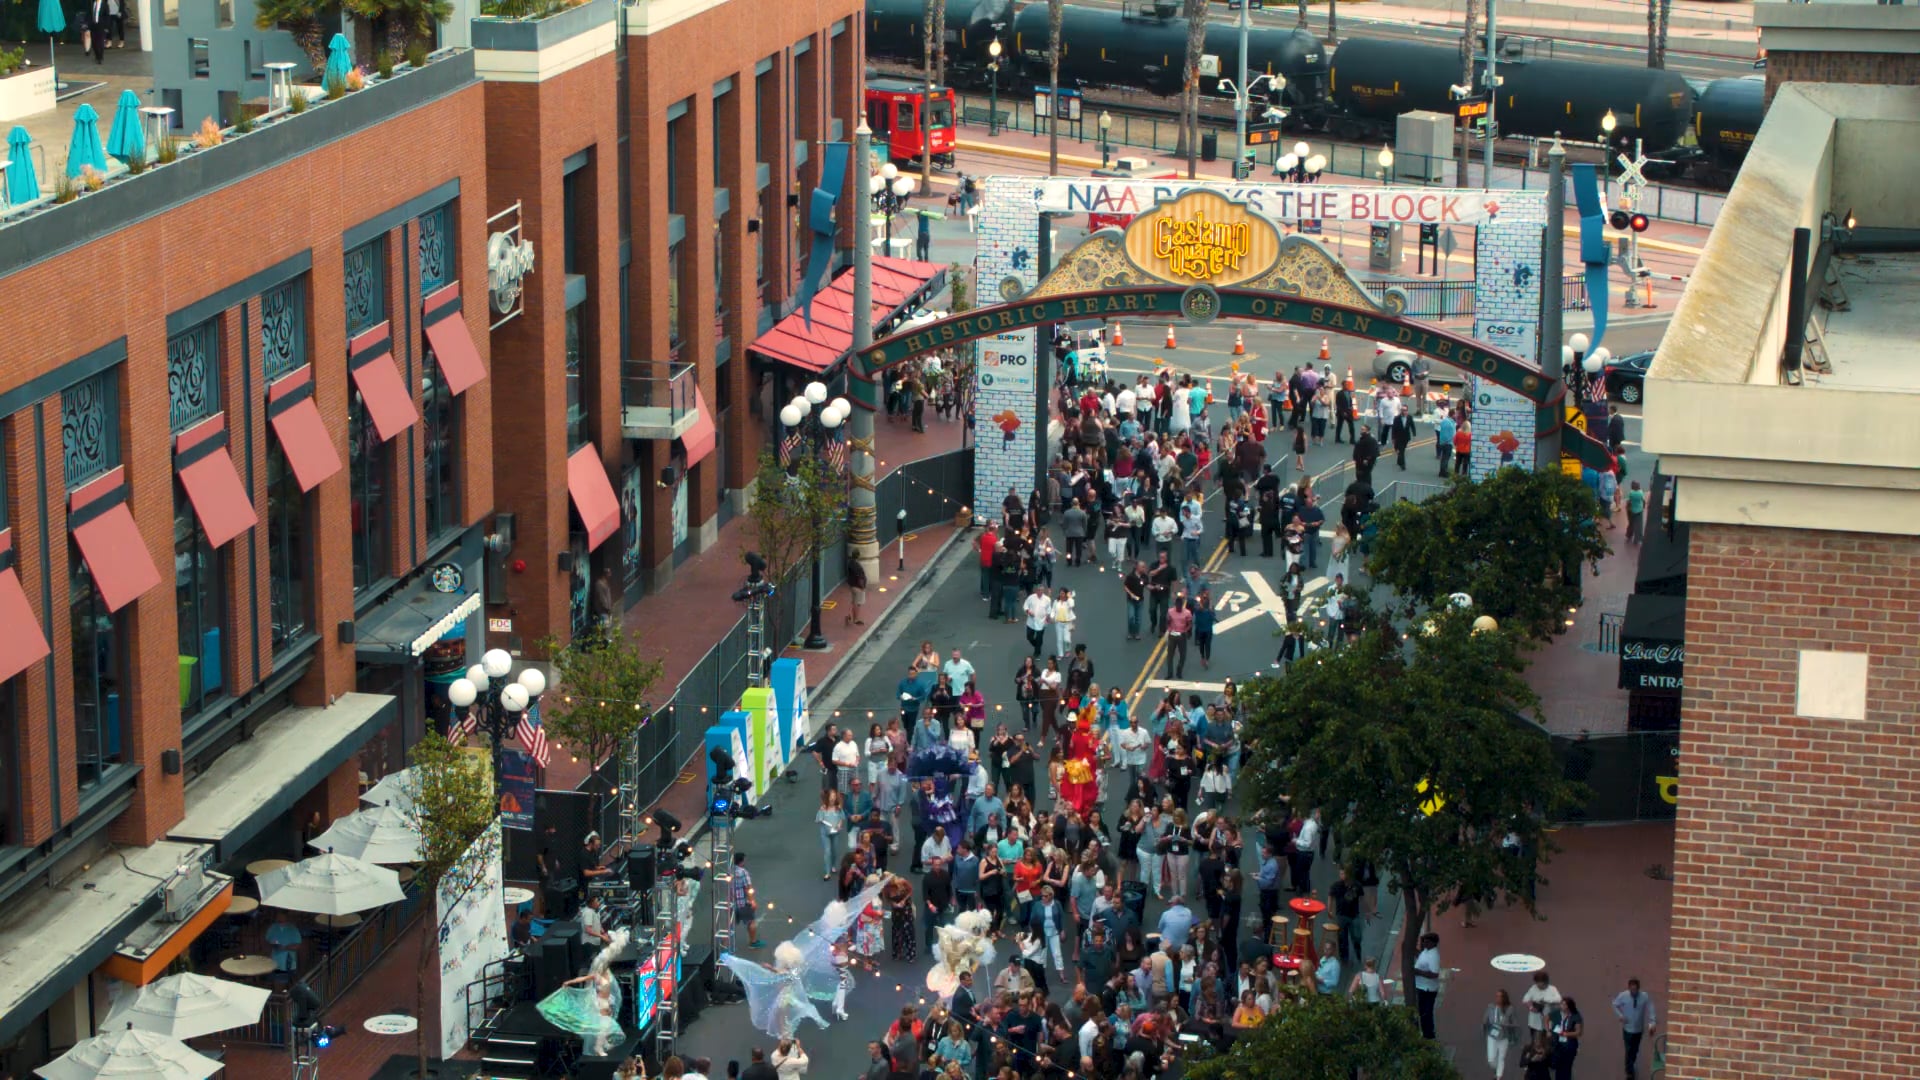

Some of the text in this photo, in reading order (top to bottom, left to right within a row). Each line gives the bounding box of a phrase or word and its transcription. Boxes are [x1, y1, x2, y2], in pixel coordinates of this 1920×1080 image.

[1067, 183, 1141, 212] NAA
[1275, 190, 1338, 220] THE
[1351, 192, 1461, 223] BLOCK
[1155, 210, 1250, 259] Gaslamp
[904, 293, 1498, 375] HISTORIC HEART OF SAN DIEGO
[1486, 324, 1516, 335] CSC
[1000, 354, 1028, 366] PRO
[490, 619, 510, 628] FDC
